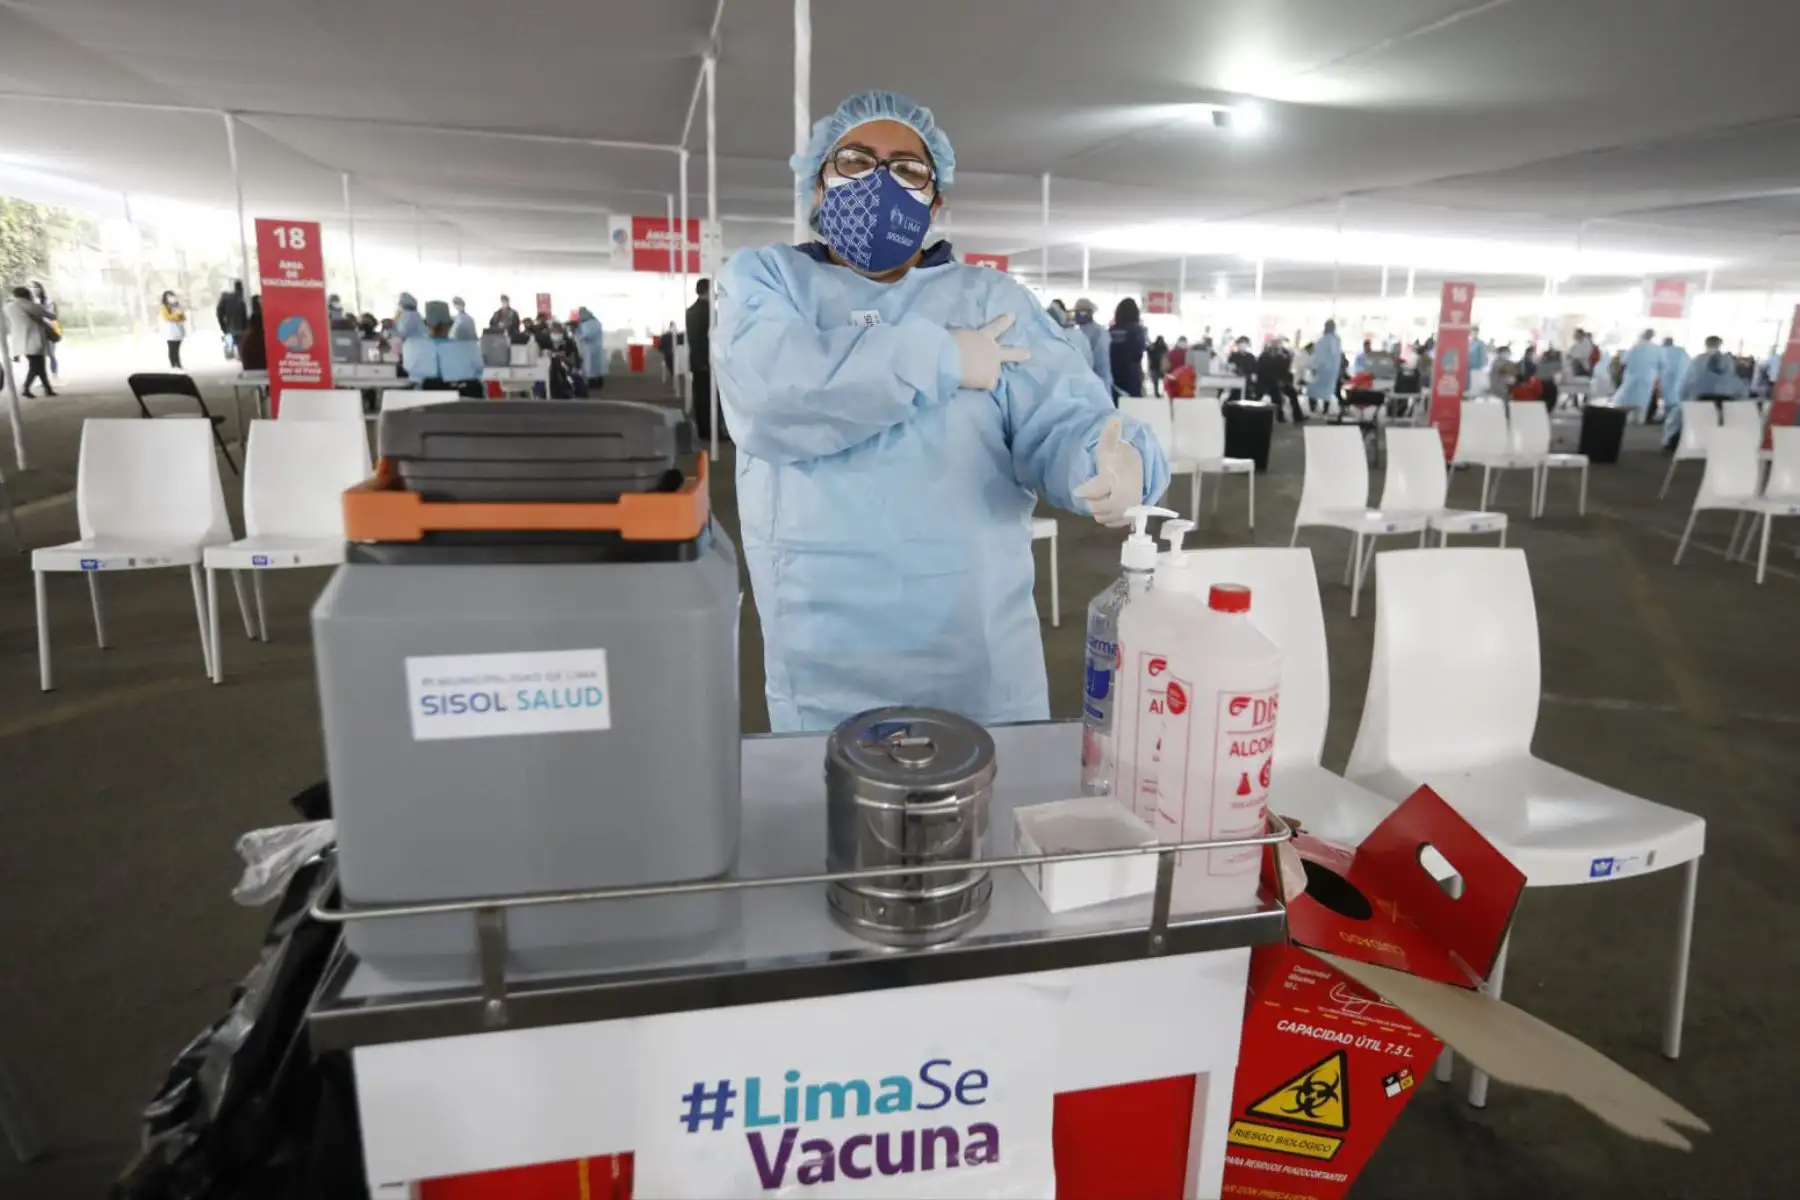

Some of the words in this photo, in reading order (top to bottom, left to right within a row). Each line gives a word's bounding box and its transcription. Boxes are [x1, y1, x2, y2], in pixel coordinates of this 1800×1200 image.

[272, 225, 306, 249] 18
[420, 691, 509, 717] SISOL
[516, 685, 604, 712] SALUD
[1277, 1019, 1354, 1045] CAPACIDAD
[1354, 1034, 1382, 1052] ÚTIL
[1384, 1042, 1404, 1056] 7.5
[1404, 1046, 1414, 1058] L
[679, 1058, 989, 1133] #LimaSe
[1234, 1128, 1274, 1142] RIESGO
[745, 1121, 1000, 1191] Vacuna
